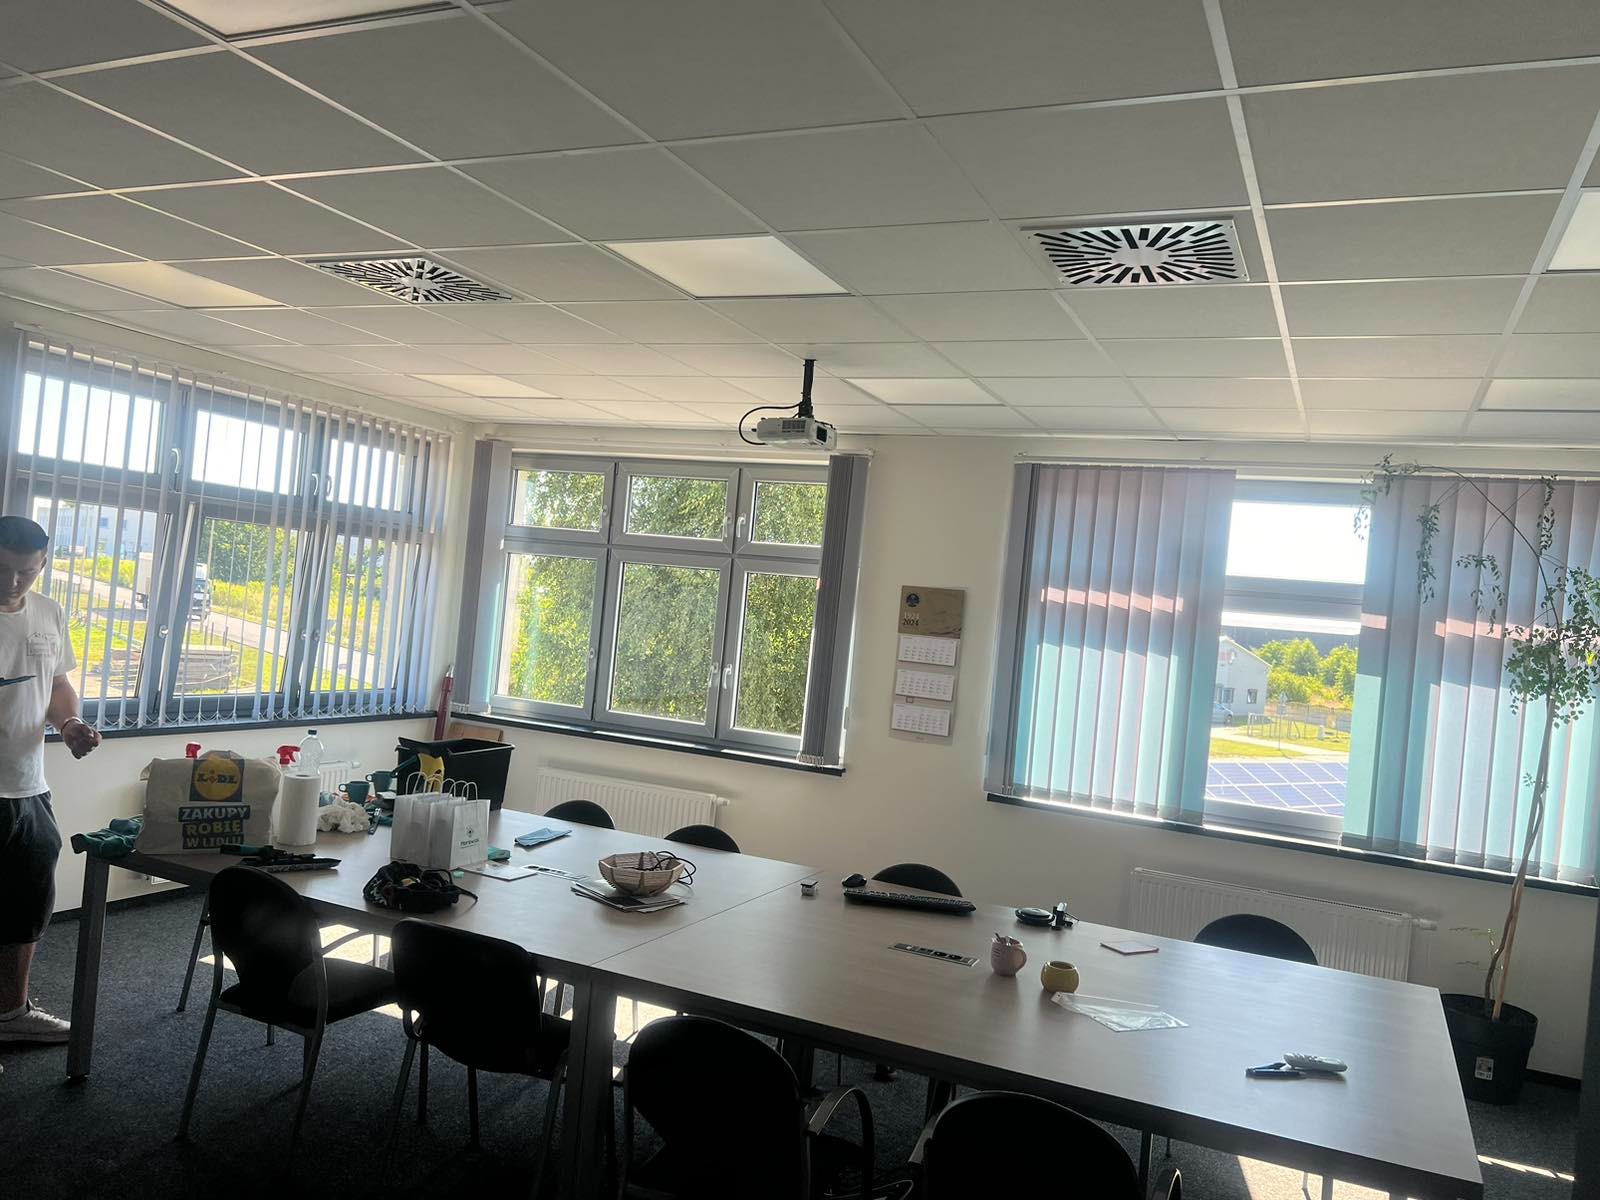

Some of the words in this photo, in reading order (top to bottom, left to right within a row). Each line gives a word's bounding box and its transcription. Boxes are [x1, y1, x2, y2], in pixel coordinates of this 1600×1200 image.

[182, 807, 248, 820] ZAKUPY
[187, 837, 199, 849] W
[203, 836, 241, 848] LIDLU
